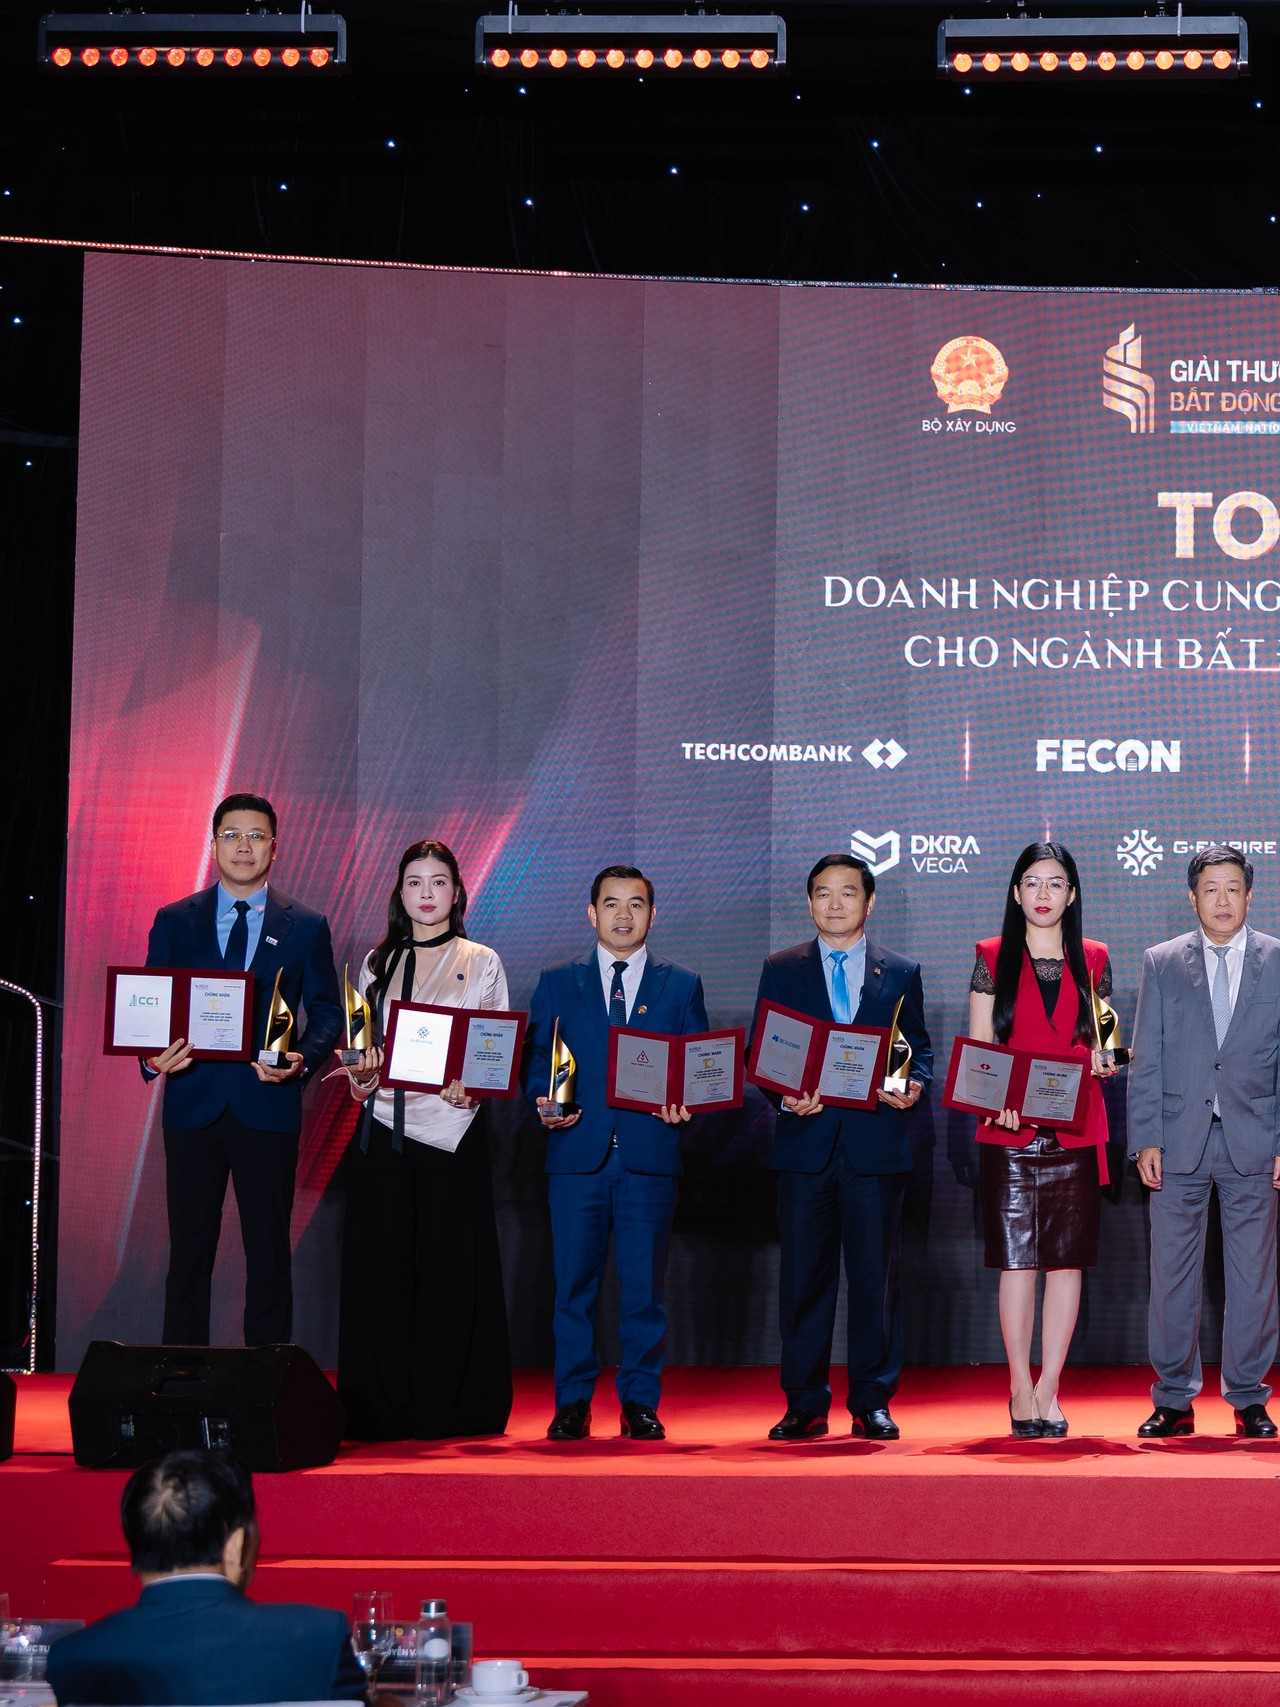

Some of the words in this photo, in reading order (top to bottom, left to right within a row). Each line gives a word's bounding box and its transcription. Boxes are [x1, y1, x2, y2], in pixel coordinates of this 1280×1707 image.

[1170, 355, 1219, 382] GIẢI
[1170, 387, 1214, 412] BẤT
[922, 418, 942, 434] BỘ
[946, 418, 971, 432] XÂY
[976, 420, 1016, 434] DỰNG
[1186, 423, 1240, 433] VIETNAM
[823, 576, 979, 608] DOANH
[993, 573, 1149, 617] NGHIỆP
[904, 634, 999, 668] CHO
[1011, 631, 1164, 669] NGÀNH
[1177, 628, 1264, 670] BẤT
[681, 743, 852, 762] TECHCOMBANK
[1036, 739, 1180, 773] FECON
[911, 835, 980, 854] DKRA
[911, 857, 968, 873] VEGA
[138, 996, 159, 1006] CC1
